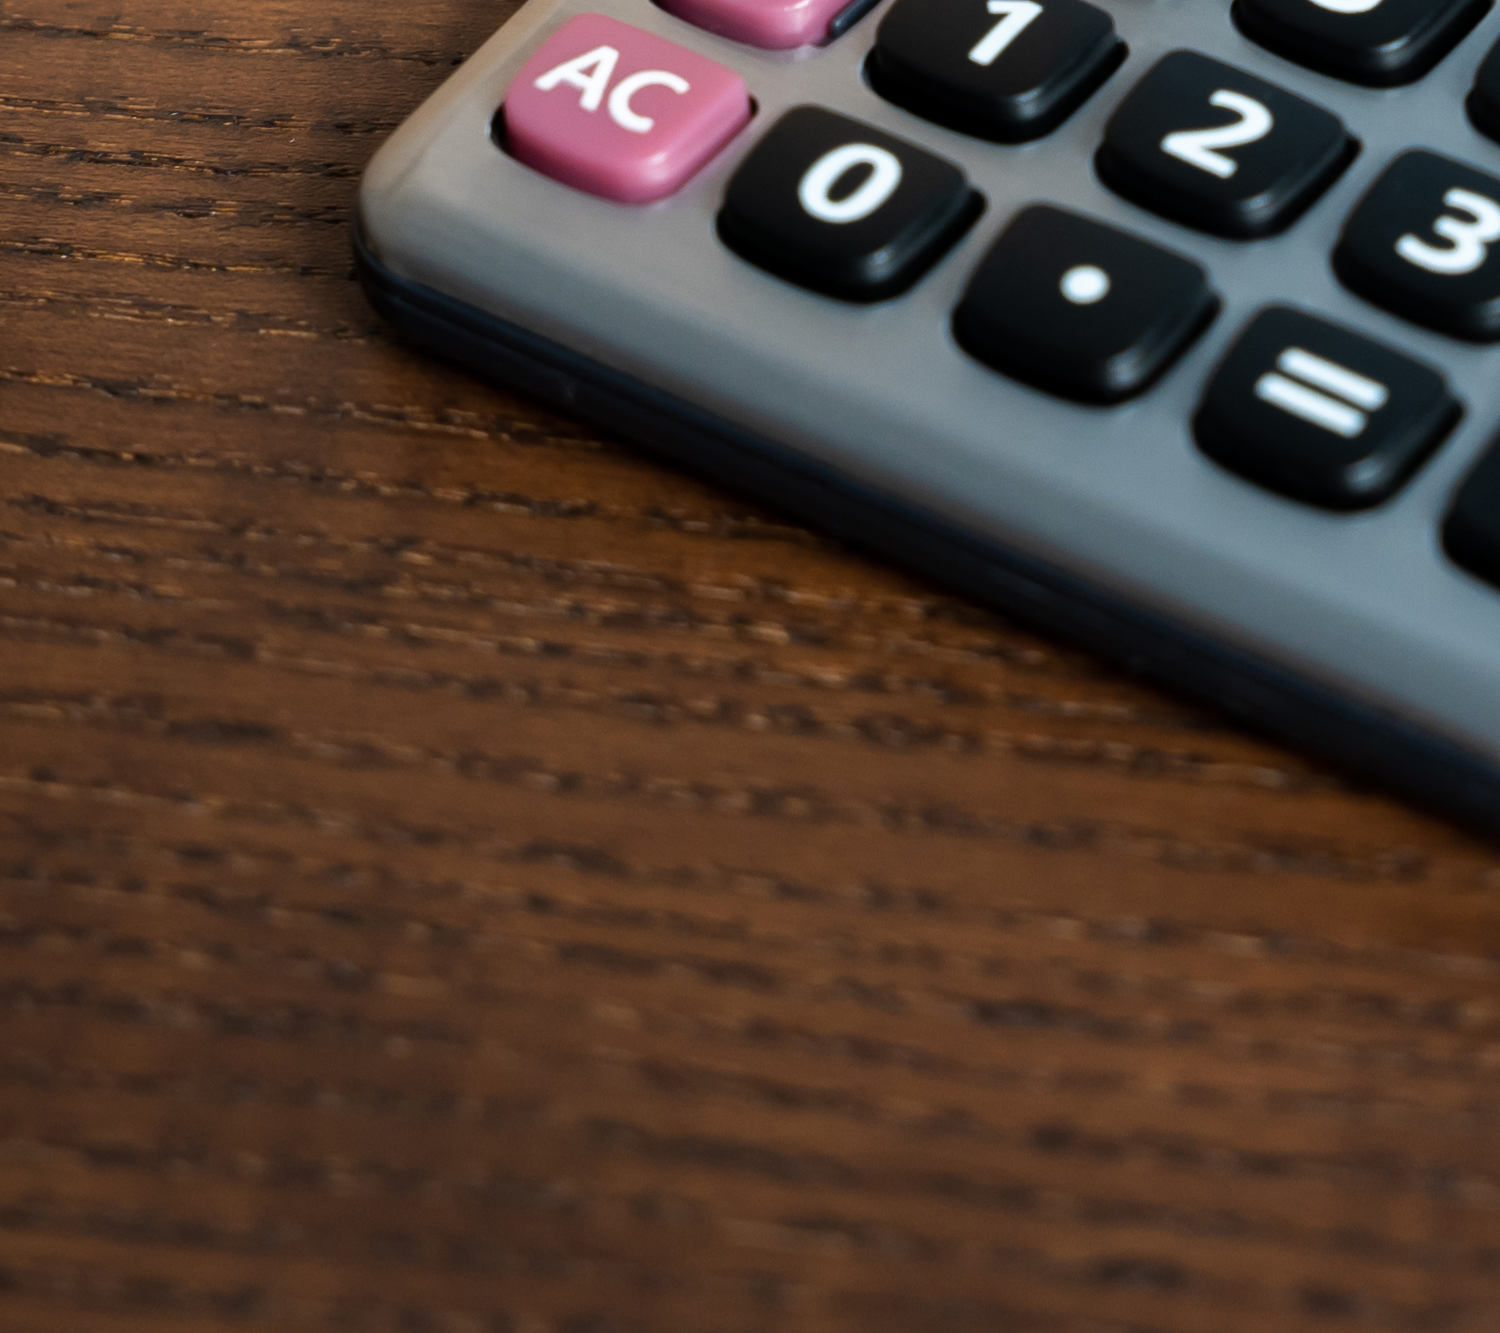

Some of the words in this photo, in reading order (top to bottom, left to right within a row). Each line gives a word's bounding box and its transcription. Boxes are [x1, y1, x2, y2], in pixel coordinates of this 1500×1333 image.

[534, 44, 691, 133] AC
[1161, 88, 1274, 179] 2
[798, 142, 903, 224] 0
